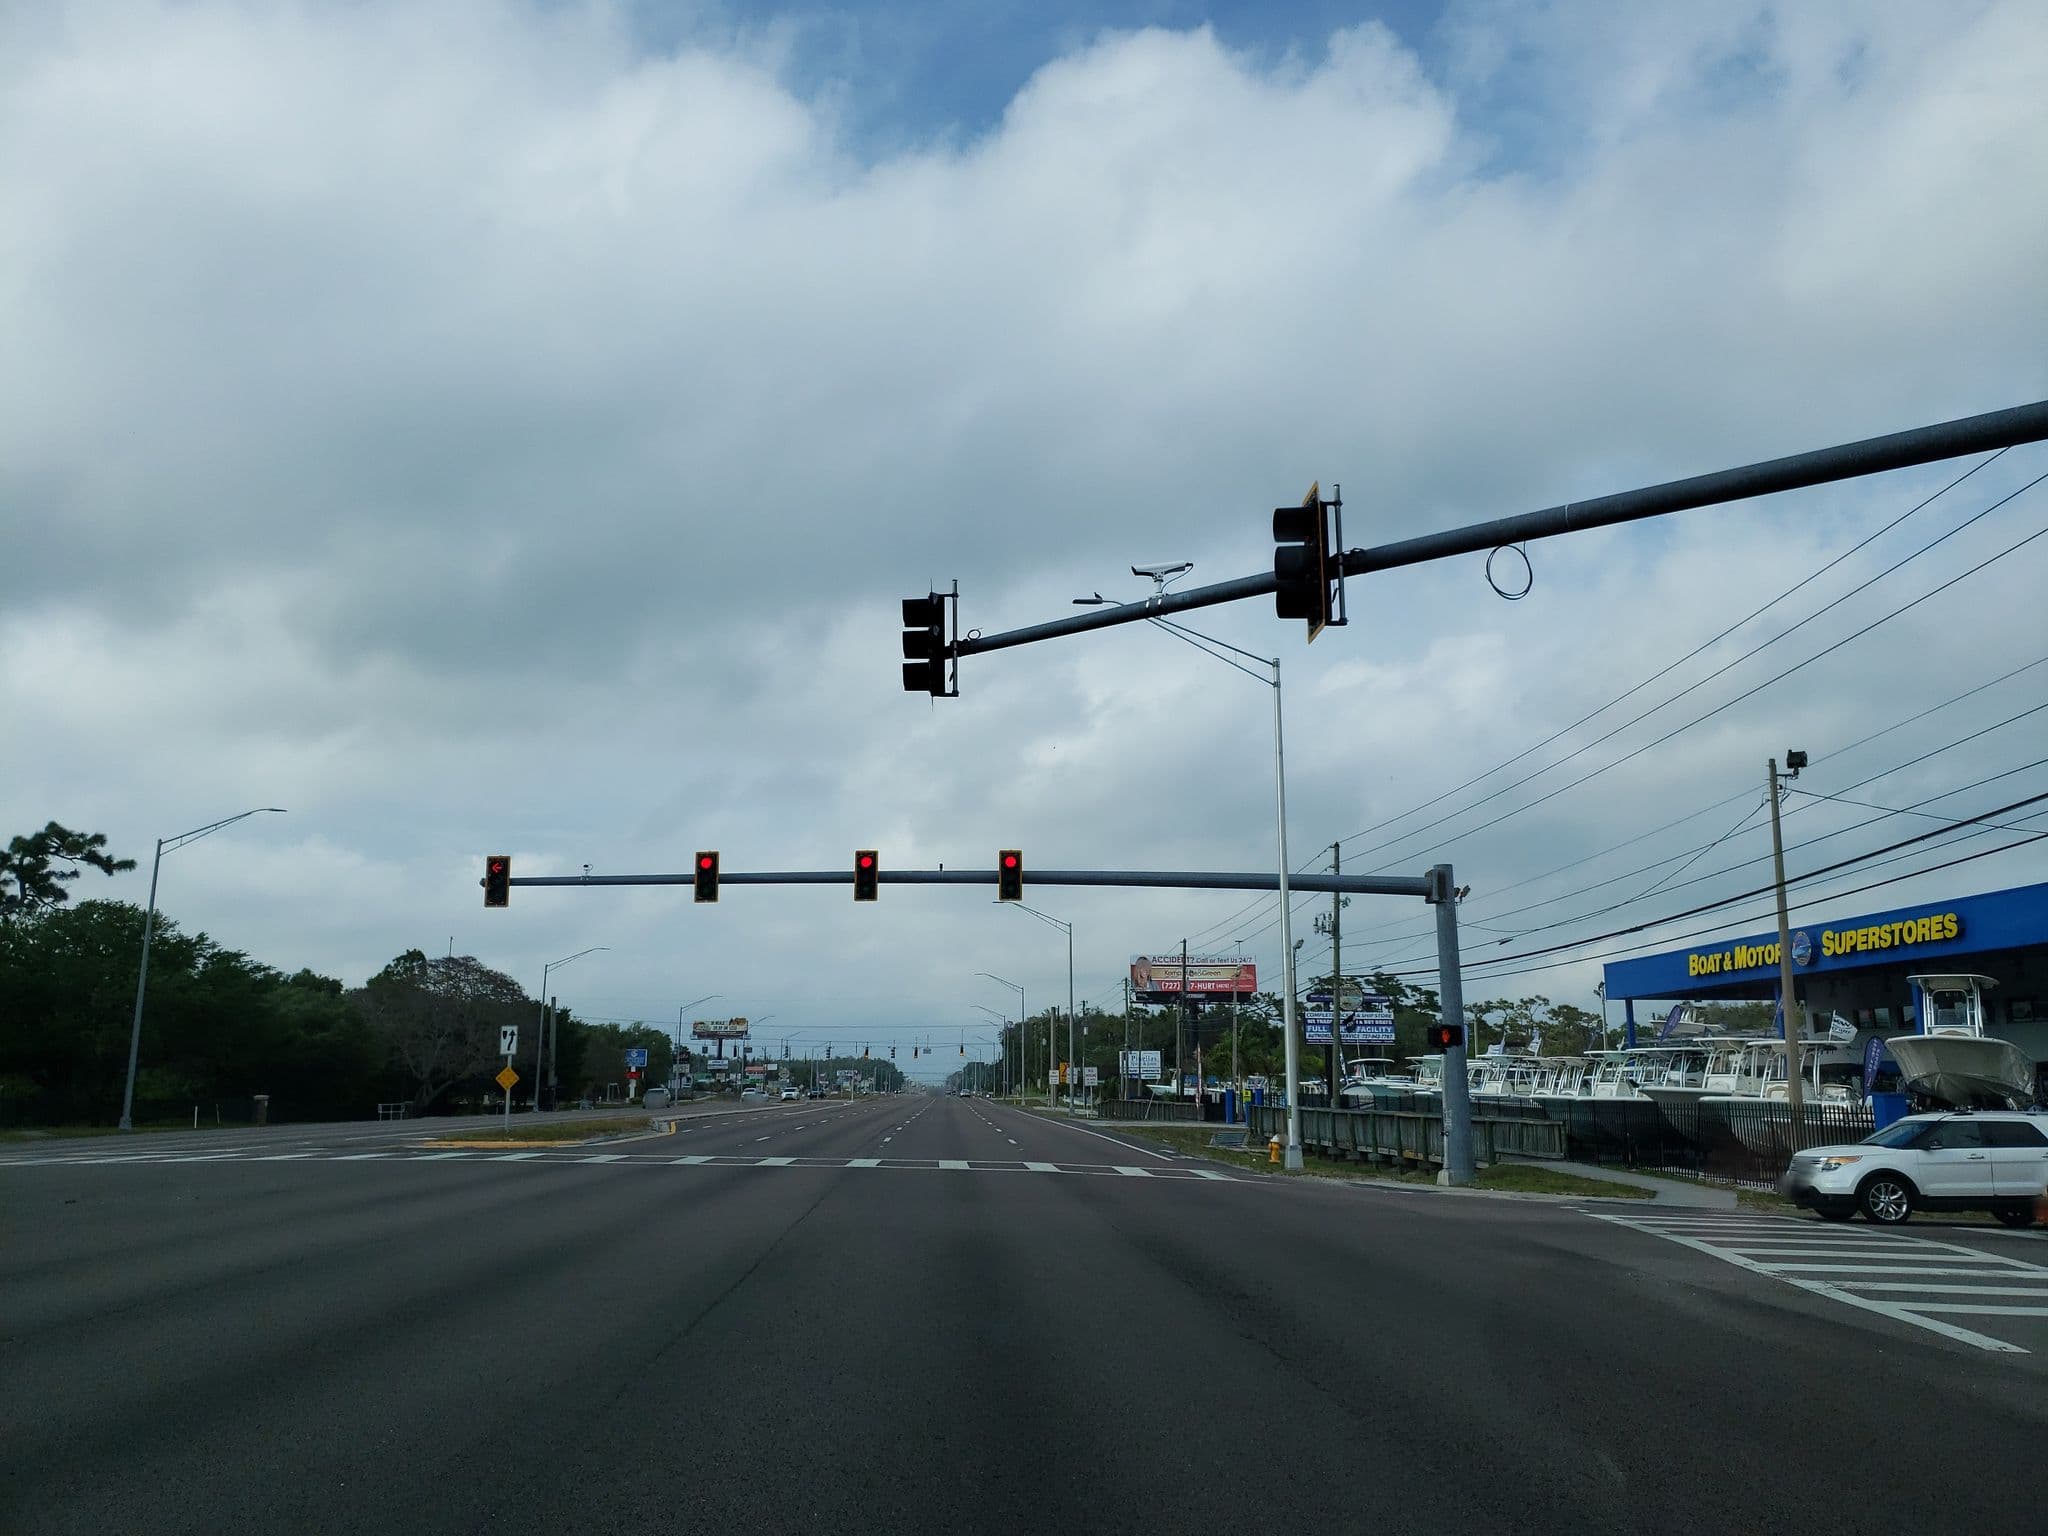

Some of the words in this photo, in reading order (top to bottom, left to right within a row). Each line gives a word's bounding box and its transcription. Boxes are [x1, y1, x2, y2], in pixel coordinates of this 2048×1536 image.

[1152, 956, 1195, 964] ACCIDET?
[1689, 953, 1722, 976] BOAT
[1723, 951, 1732, 971] &
[1822, 912, 1958, 956] SUPERSTORES
